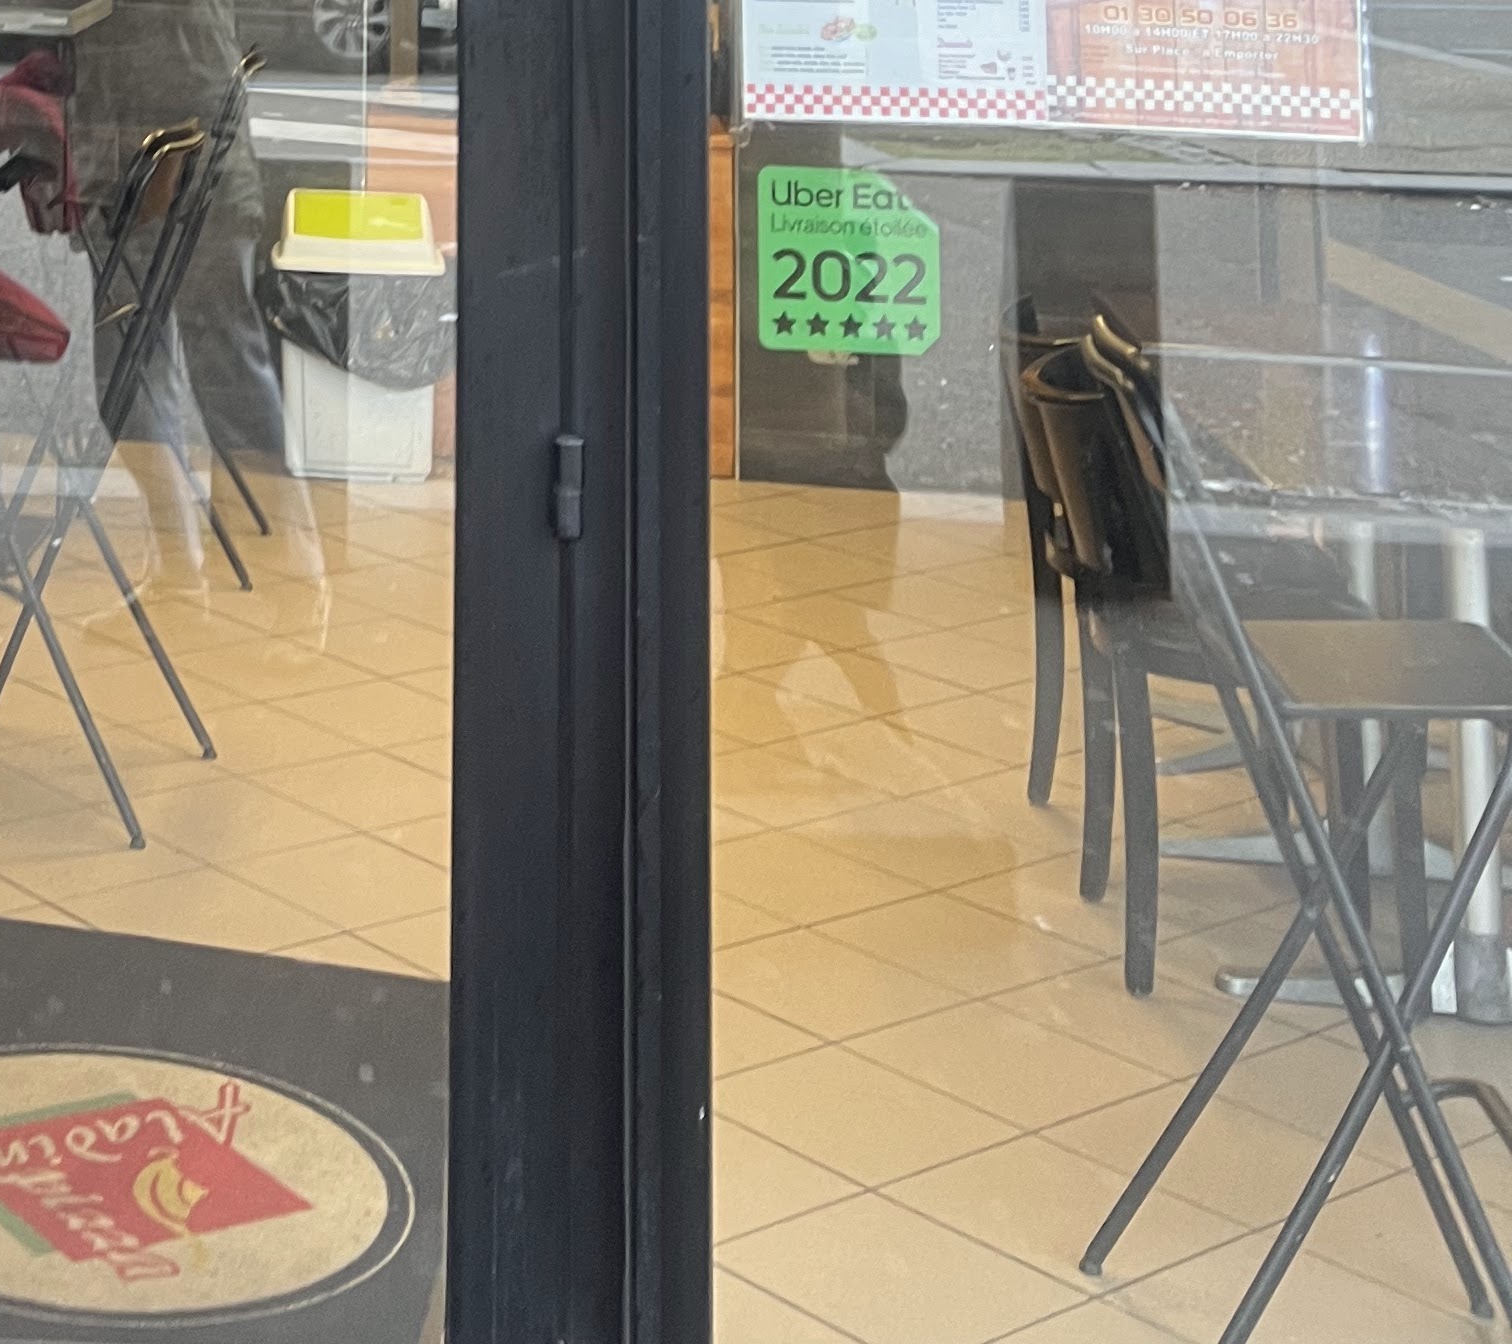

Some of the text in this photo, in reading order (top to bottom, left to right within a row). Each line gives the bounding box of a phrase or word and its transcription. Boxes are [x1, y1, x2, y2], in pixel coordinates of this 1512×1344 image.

[1104, 5, 1298, 29] 01 30 50 06 36
[1146, 27, 1187, 40] 14H00
[1216, 30, 1257, 42] 17H00
[1276, 33, 1319, 46] 22H30
[1125, 44, 1148, 56] Sur
[1215, 47, 1279, 62] Emporter
[771, 179, 910, 212] Uber Eat
[770, 213, 854, 236] Livraison
[772, 248, 928, 305] 2022
